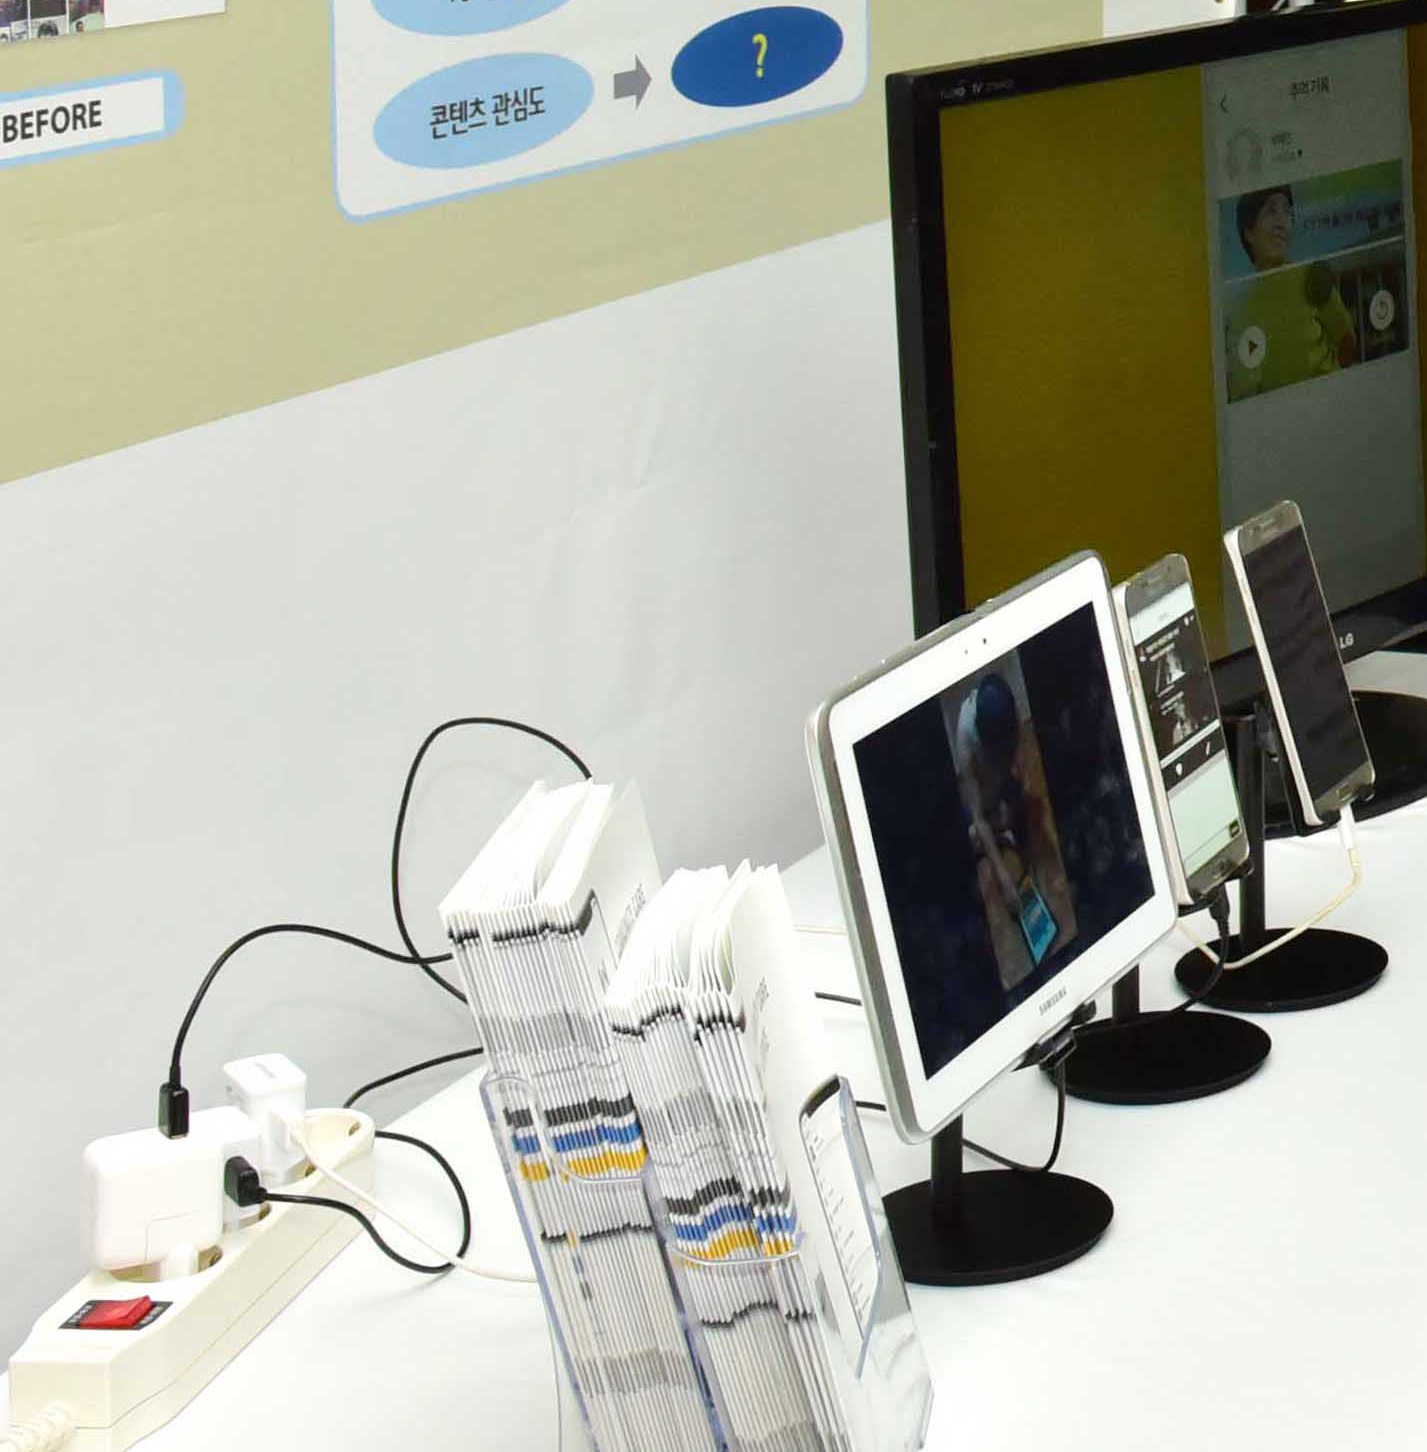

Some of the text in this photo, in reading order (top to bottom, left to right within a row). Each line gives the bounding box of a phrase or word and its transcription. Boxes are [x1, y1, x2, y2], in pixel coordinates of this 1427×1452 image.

[752, 33, 768, 78] ?
[3, 100, 103, 144] BEFORE
[430, 85, 545, 140] 콘텐츠 관심도
[1339, 632, 1354, 649] LG
